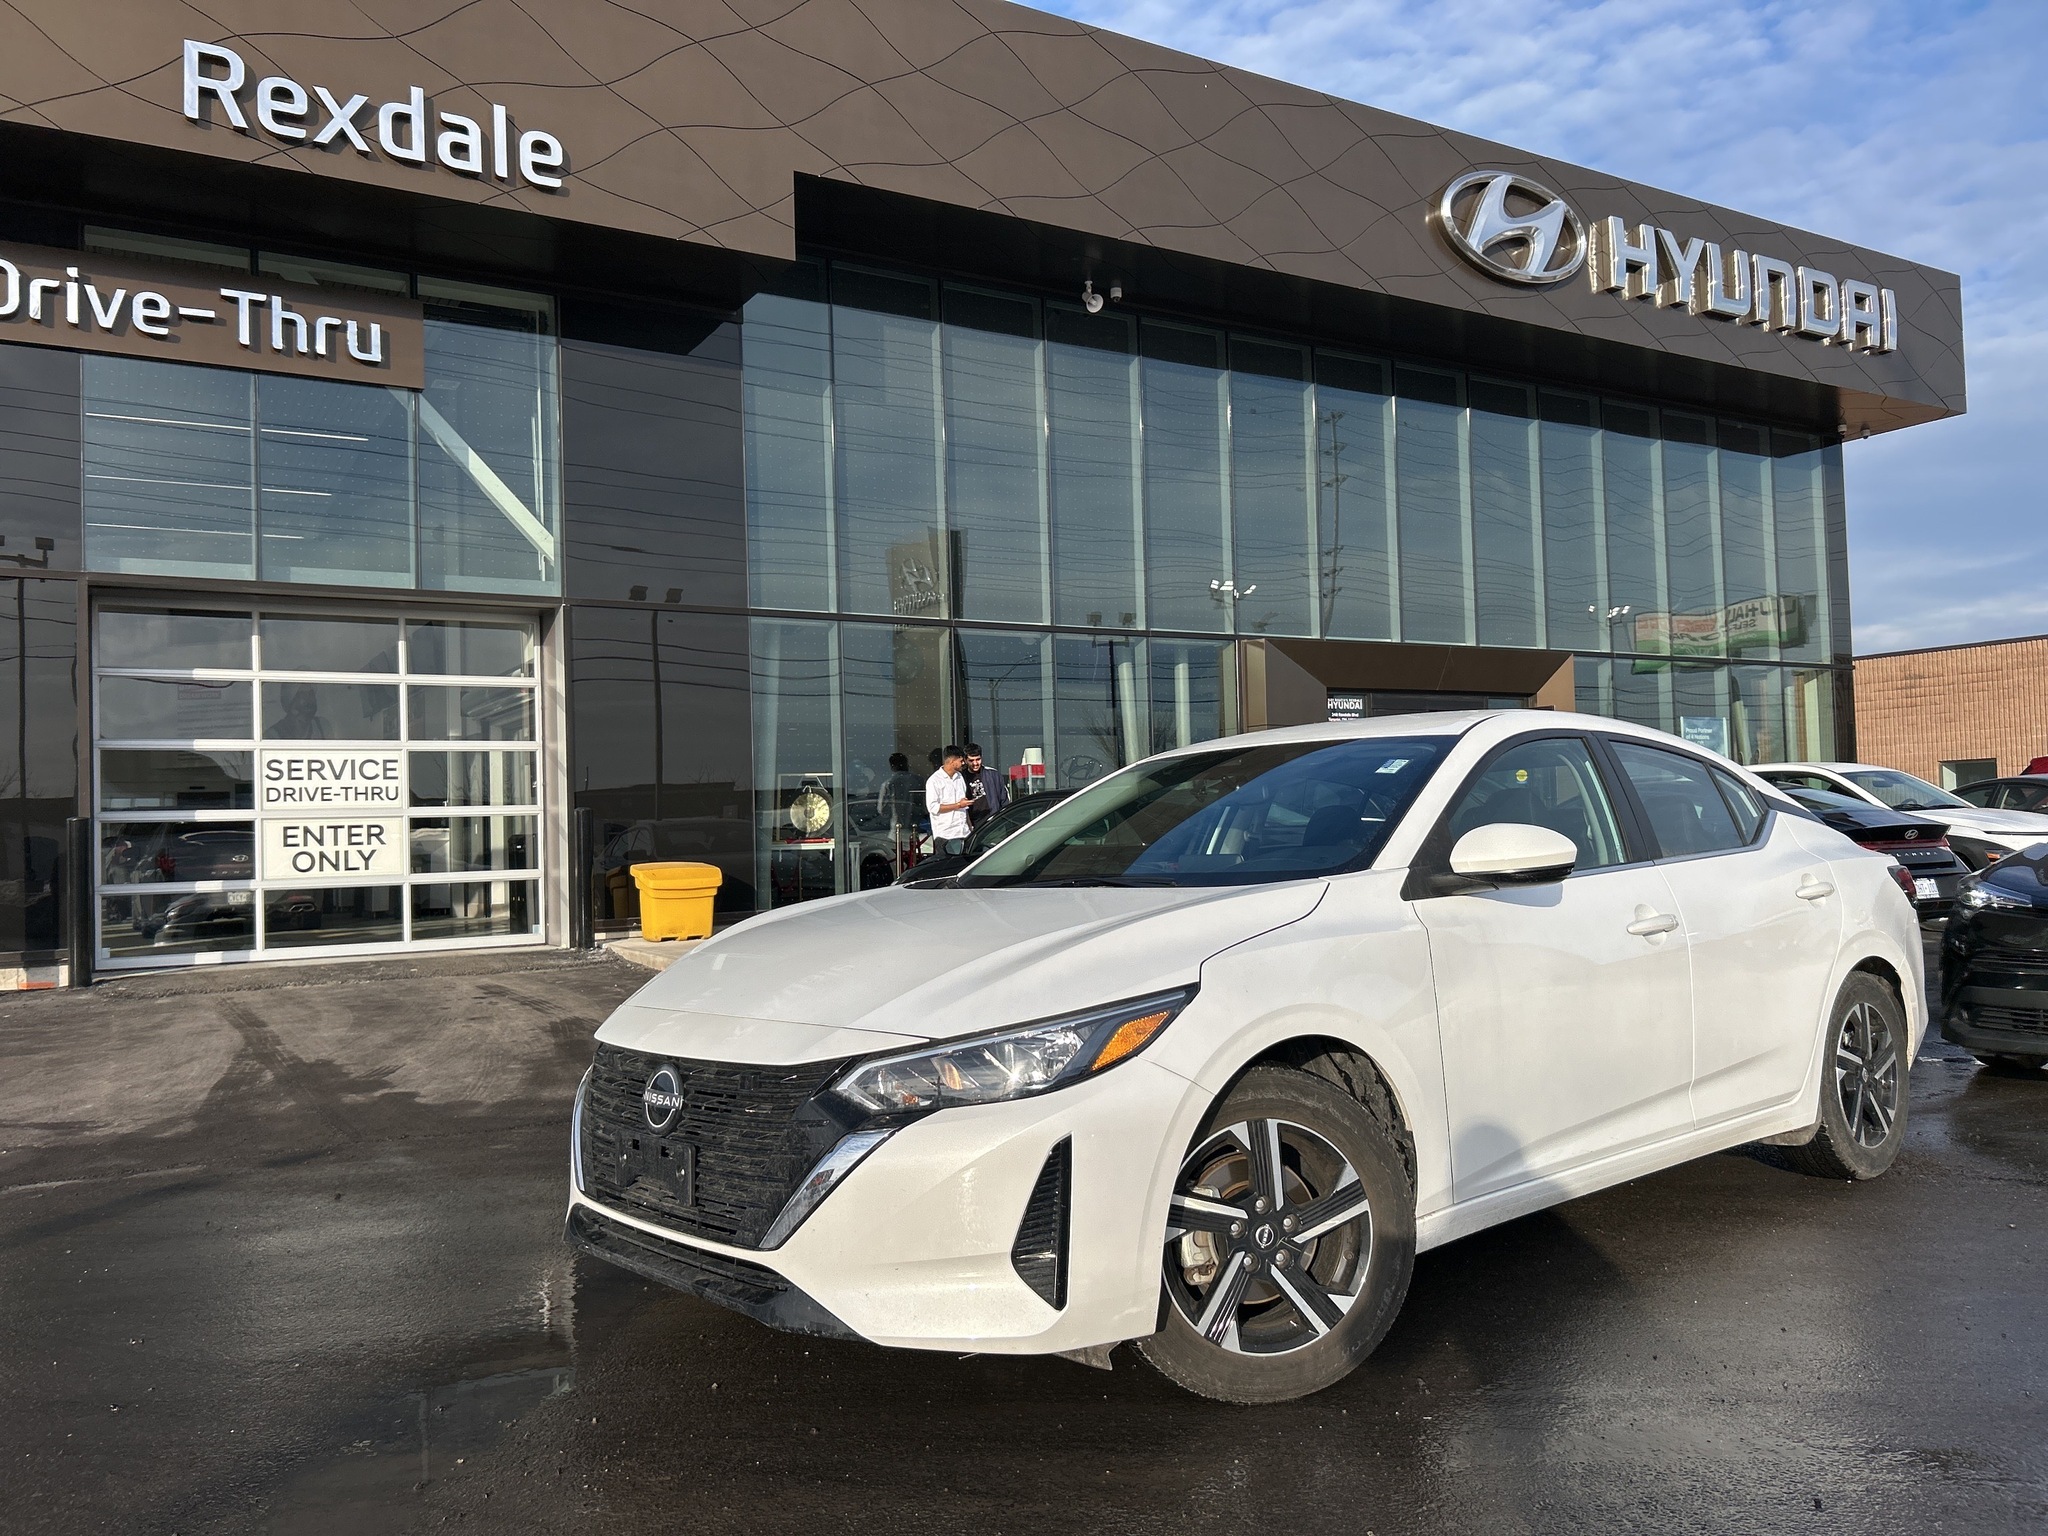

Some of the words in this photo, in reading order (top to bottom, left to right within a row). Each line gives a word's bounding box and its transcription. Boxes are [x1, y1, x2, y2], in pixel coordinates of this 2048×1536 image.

[183, 38, 563, 188] Rexdale
[1590, 215, 1898, 353] HYUNDAI
[0, 258, 382, 363] Drive-Thru
[1327, 698, 1362, 710] HYUNDAI
[265, 758, 399, 781] SERVICE
[266, 786, 399, 802] DRIVE-THRU
[283, 824, 387, 848] ENTER
[292, 849, 377, 873] ONLY
[643, 1090, 681, 1108] NISSAN
